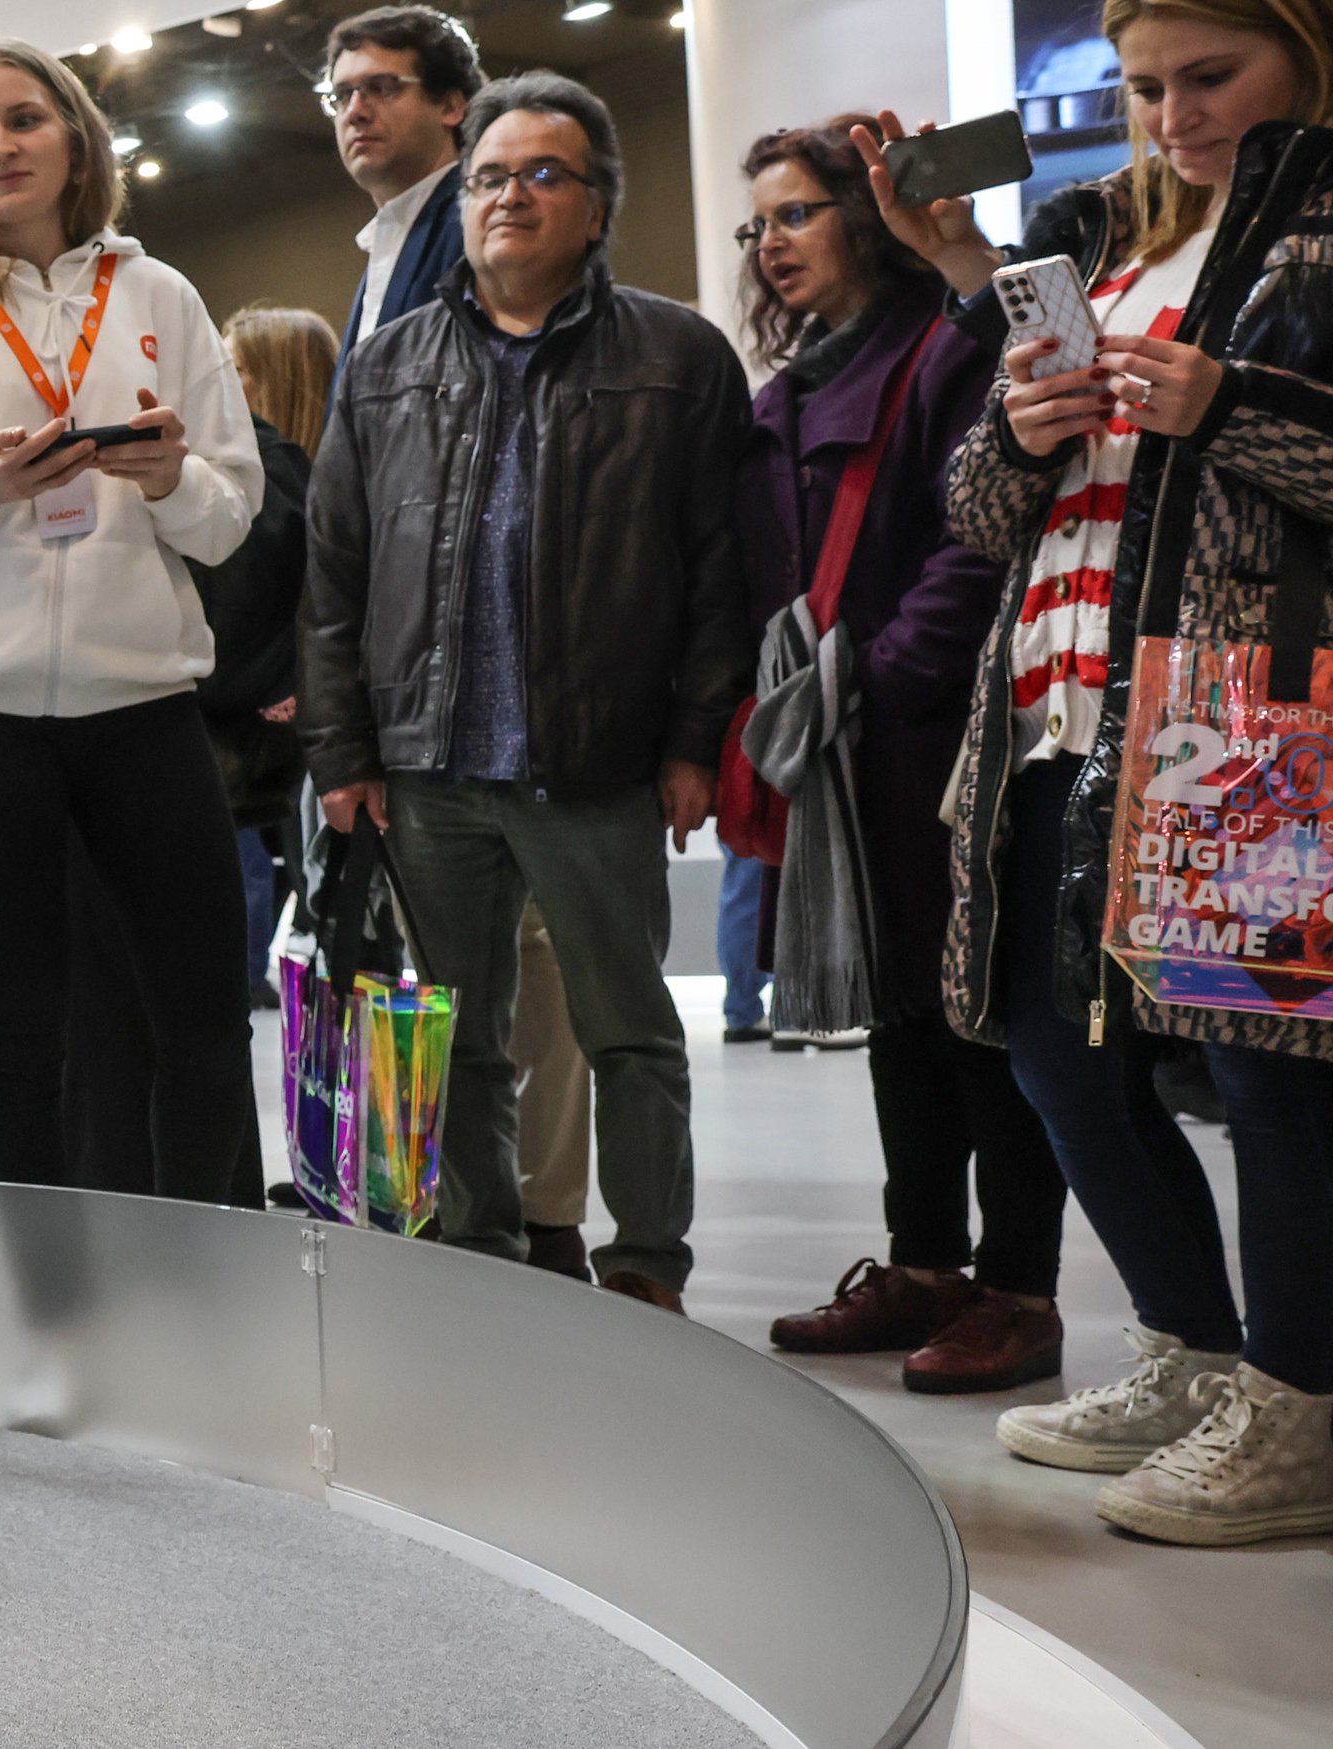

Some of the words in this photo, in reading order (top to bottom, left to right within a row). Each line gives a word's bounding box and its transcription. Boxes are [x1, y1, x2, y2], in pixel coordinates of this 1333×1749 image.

[1256, 706, 1301, 724] FOR
[1307, 708, 1333, 726] TH
[1142, 804, 1217, 831] HALF
[1223, 812, 1266, 836] OF
[1136, 832, 1333, 881] DIGITAL
[1128, 913, 1270, 958] GAME
